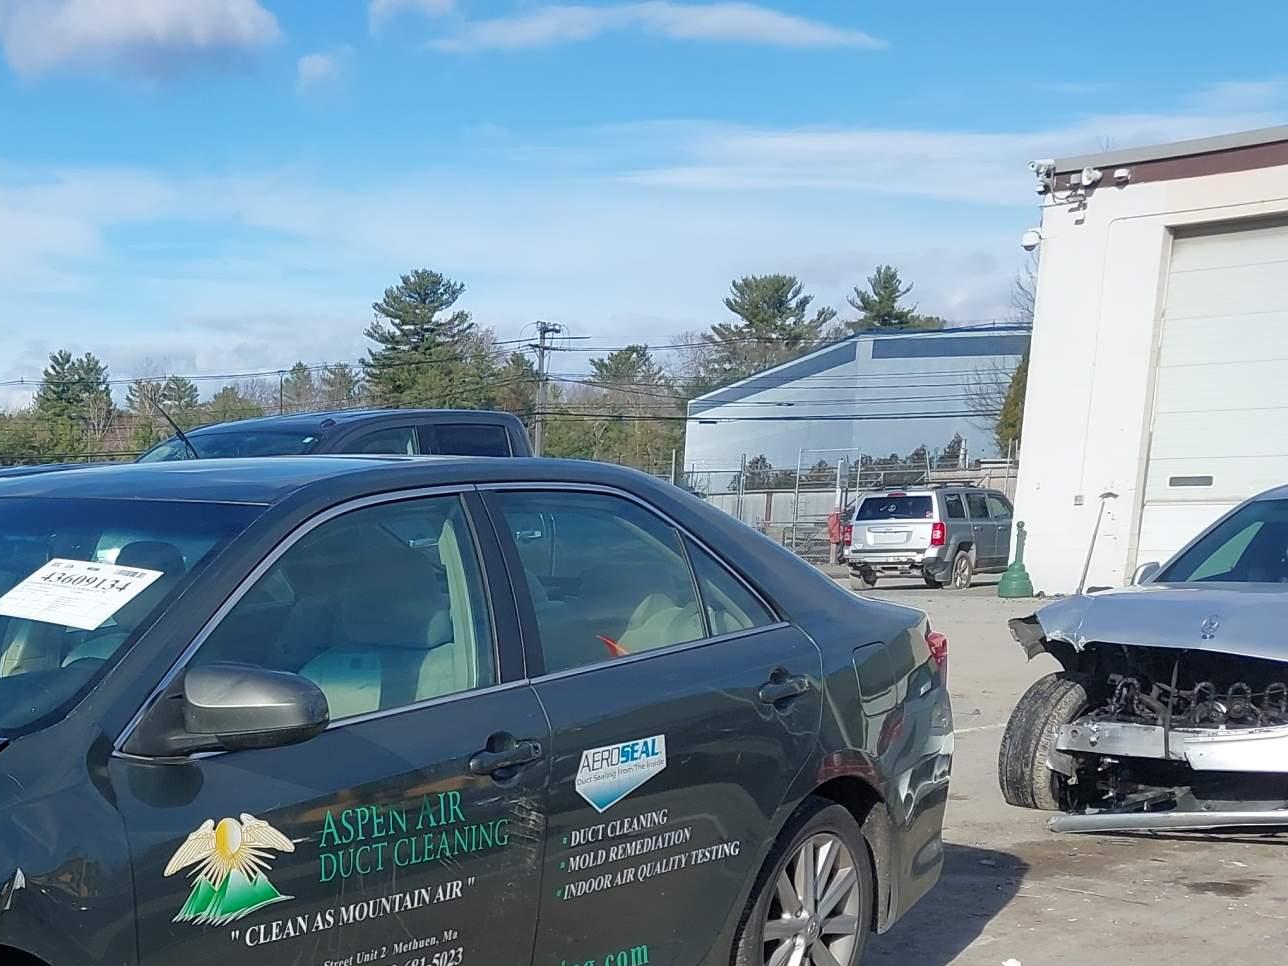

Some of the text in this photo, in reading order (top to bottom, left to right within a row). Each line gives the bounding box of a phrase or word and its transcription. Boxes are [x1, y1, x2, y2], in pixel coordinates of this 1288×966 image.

[41, 571, 133, 593] 43609134
[577, 759, 665, 786] Duct Sealing From The Inside
[580, 738, 659, 774] AEROSEAL
[319, 790, 465, 848] ASPEN AIR
[570, 808, 669, 848] DUCT CLEANING
[319, 818, 510, 883] DUCT CLEANING
[563, 841, 740, 900] INDOOR AIR QUALITY TESTING
[568, 827, 692, 873] MOLD REMEDIATION
[245, 914, 309, 947] CLEAN
[312, 909, 334, 932] AS
[339, 887, 432, 926] MOUNTAIN
[433, 880, 462, 903] AIR
[356, 949, 378, 965] Unit
[380, 947, 387, 958] 2
[443, 929, 459, 943] Ma
